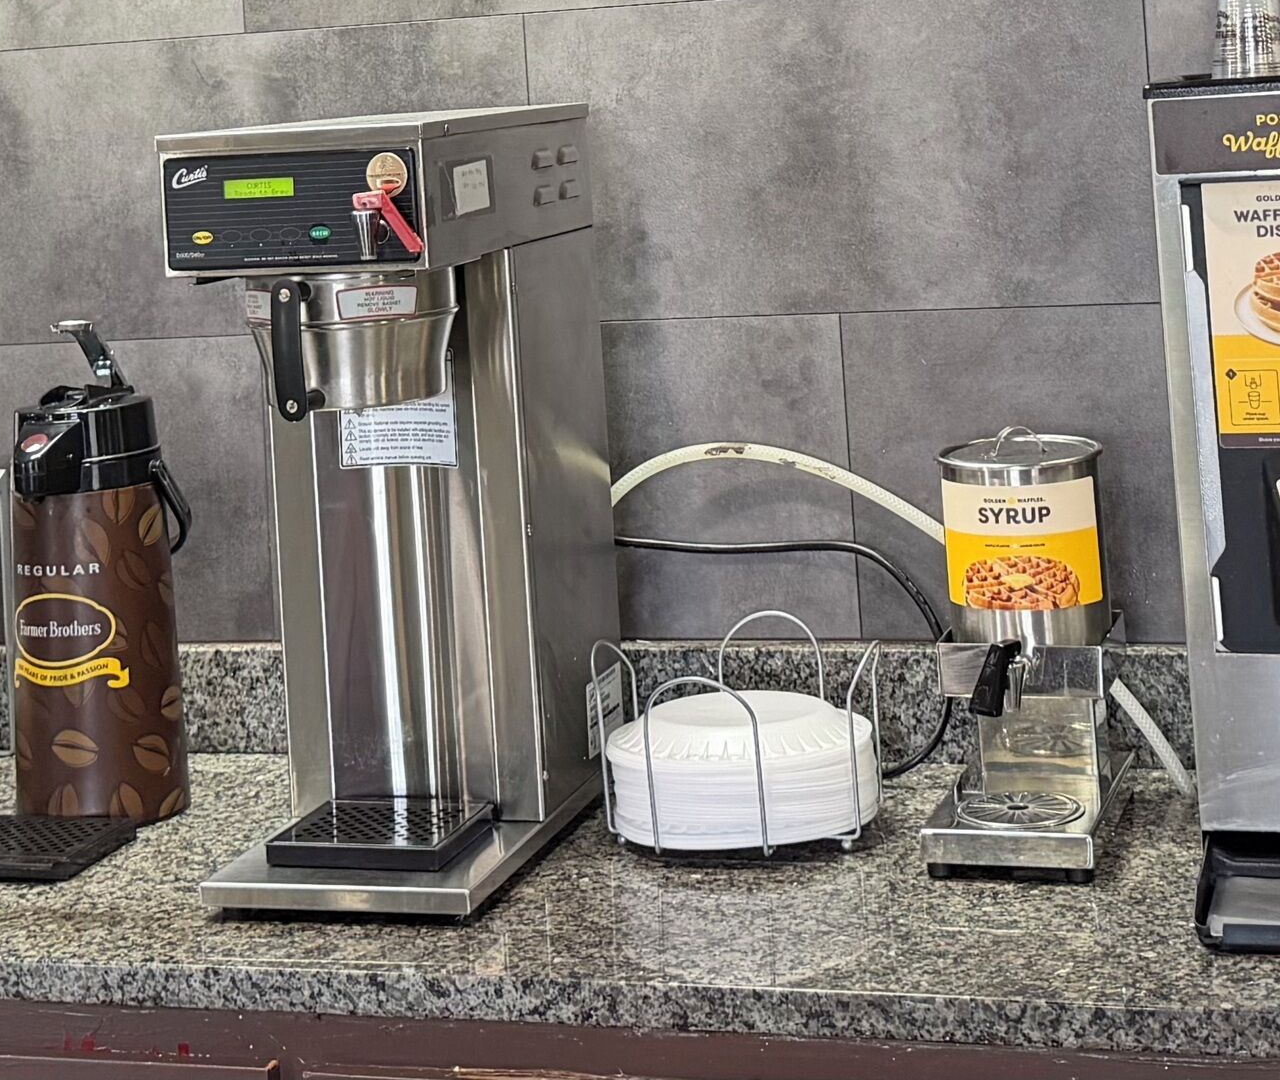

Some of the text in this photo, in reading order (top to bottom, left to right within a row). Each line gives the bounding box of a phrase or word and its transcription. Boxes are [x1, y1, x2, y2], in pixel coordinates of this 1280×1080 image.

[172, 165, 208, 189] Curtis
[978, 506, 1051, 524] SYRUP
[17, 562, 100, 576] REGULAR
[20, 620, 101, 638] Farmer Brothers
[77, 663, 108, 678] PASSION
